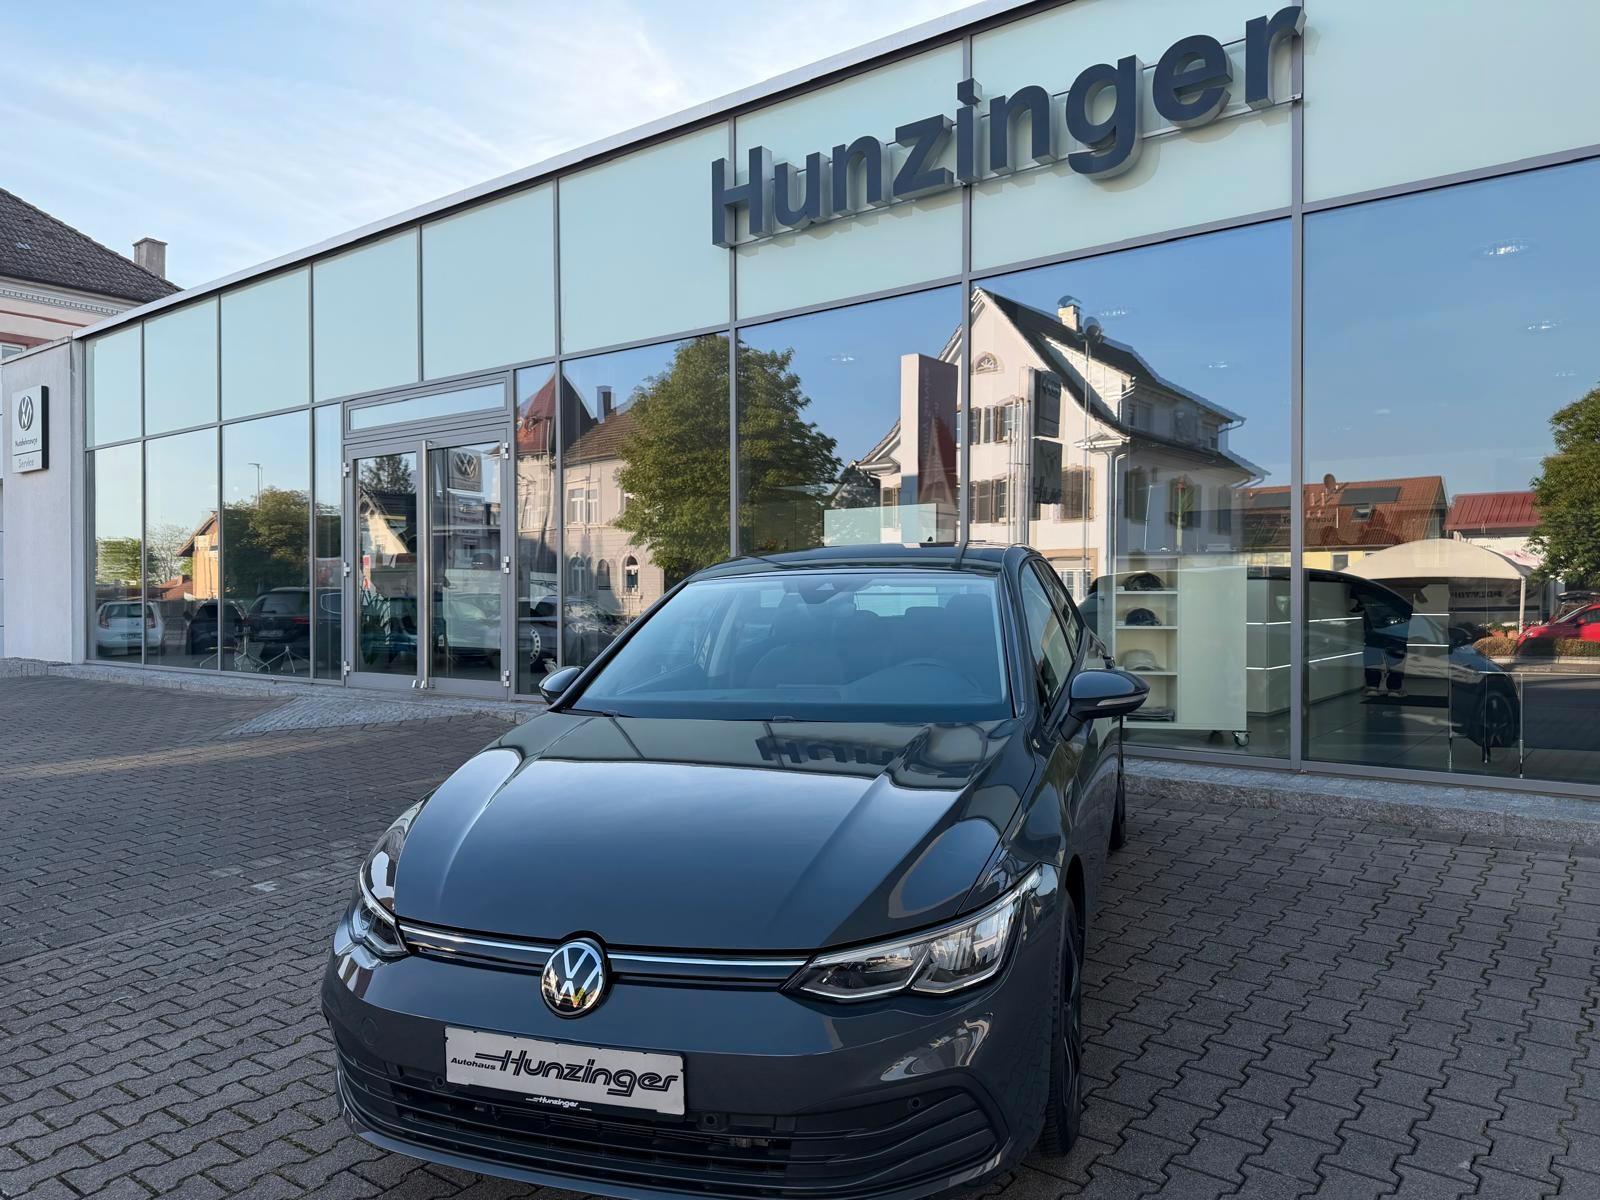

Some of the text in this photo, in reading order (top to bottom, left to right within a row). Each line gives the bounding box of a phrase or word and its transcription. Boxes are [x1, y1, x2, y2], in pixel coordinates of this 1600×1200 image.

[711, 4, 1305, 248] Hunzinger
[450, 1049, 679, 1097] Autohaus Hunzinger
[528, 1096, 579, 1108] Hunzinger
